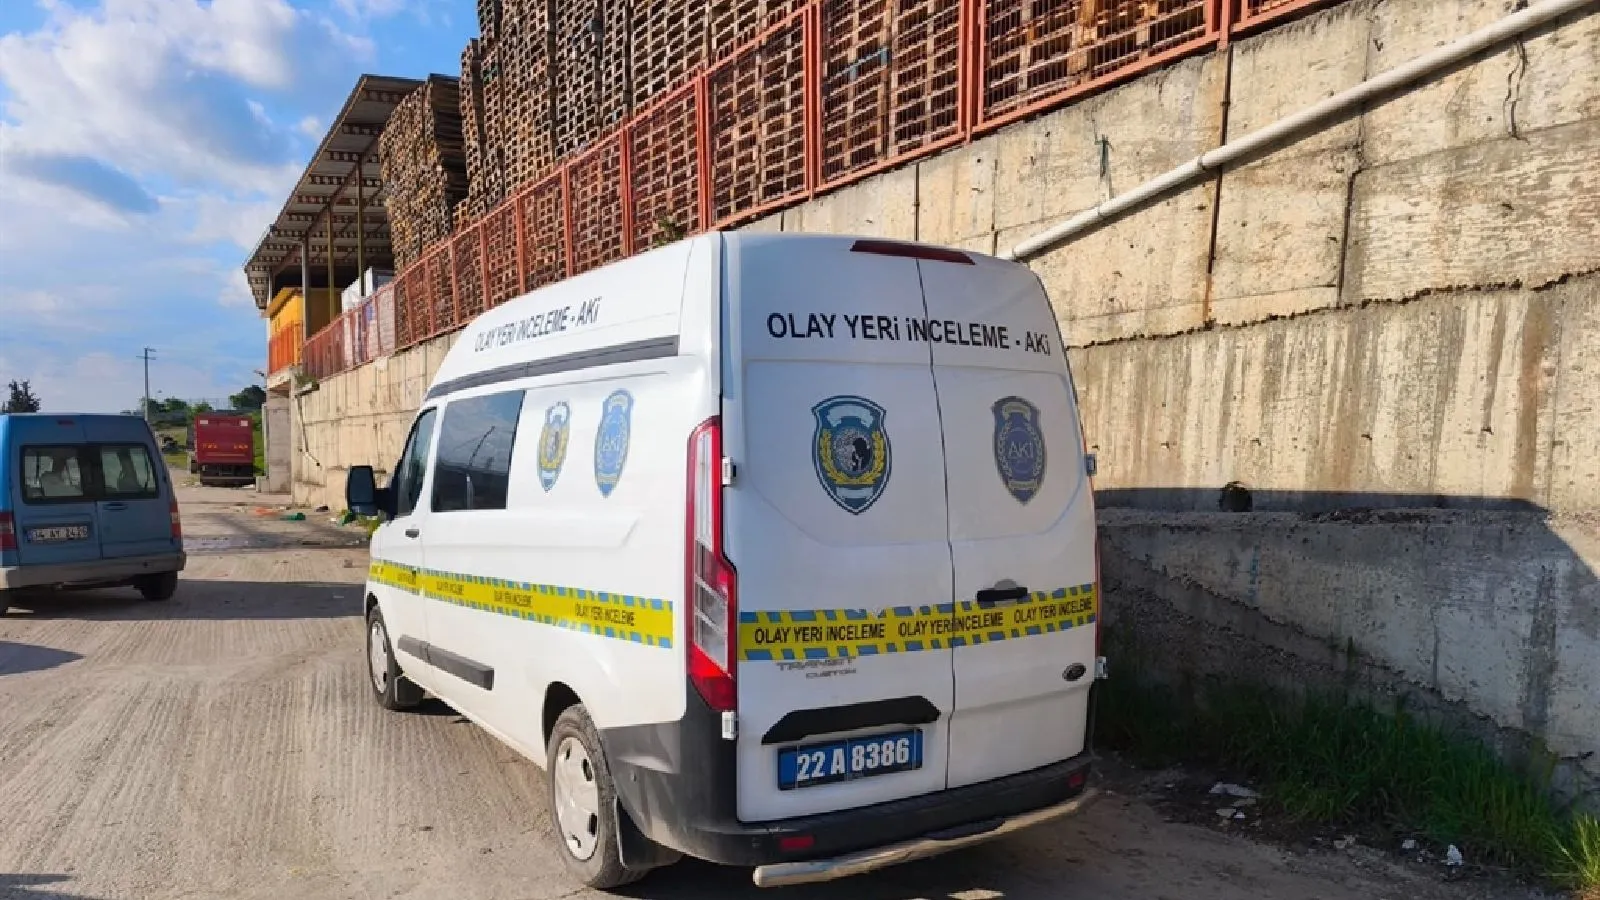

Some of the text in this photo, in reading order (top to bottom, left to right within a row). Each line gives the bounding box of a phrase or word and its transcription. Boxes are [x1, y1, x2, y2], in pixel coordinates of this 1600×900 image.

[766, 312, 836, 339] OLAY
[755, 627, 791, 644] OLAY
[898, 619, 928, 637] OLAY
[1013, 606, 1037, 624] OLAY
[797, 738, 910, 781] 22 A 8386
